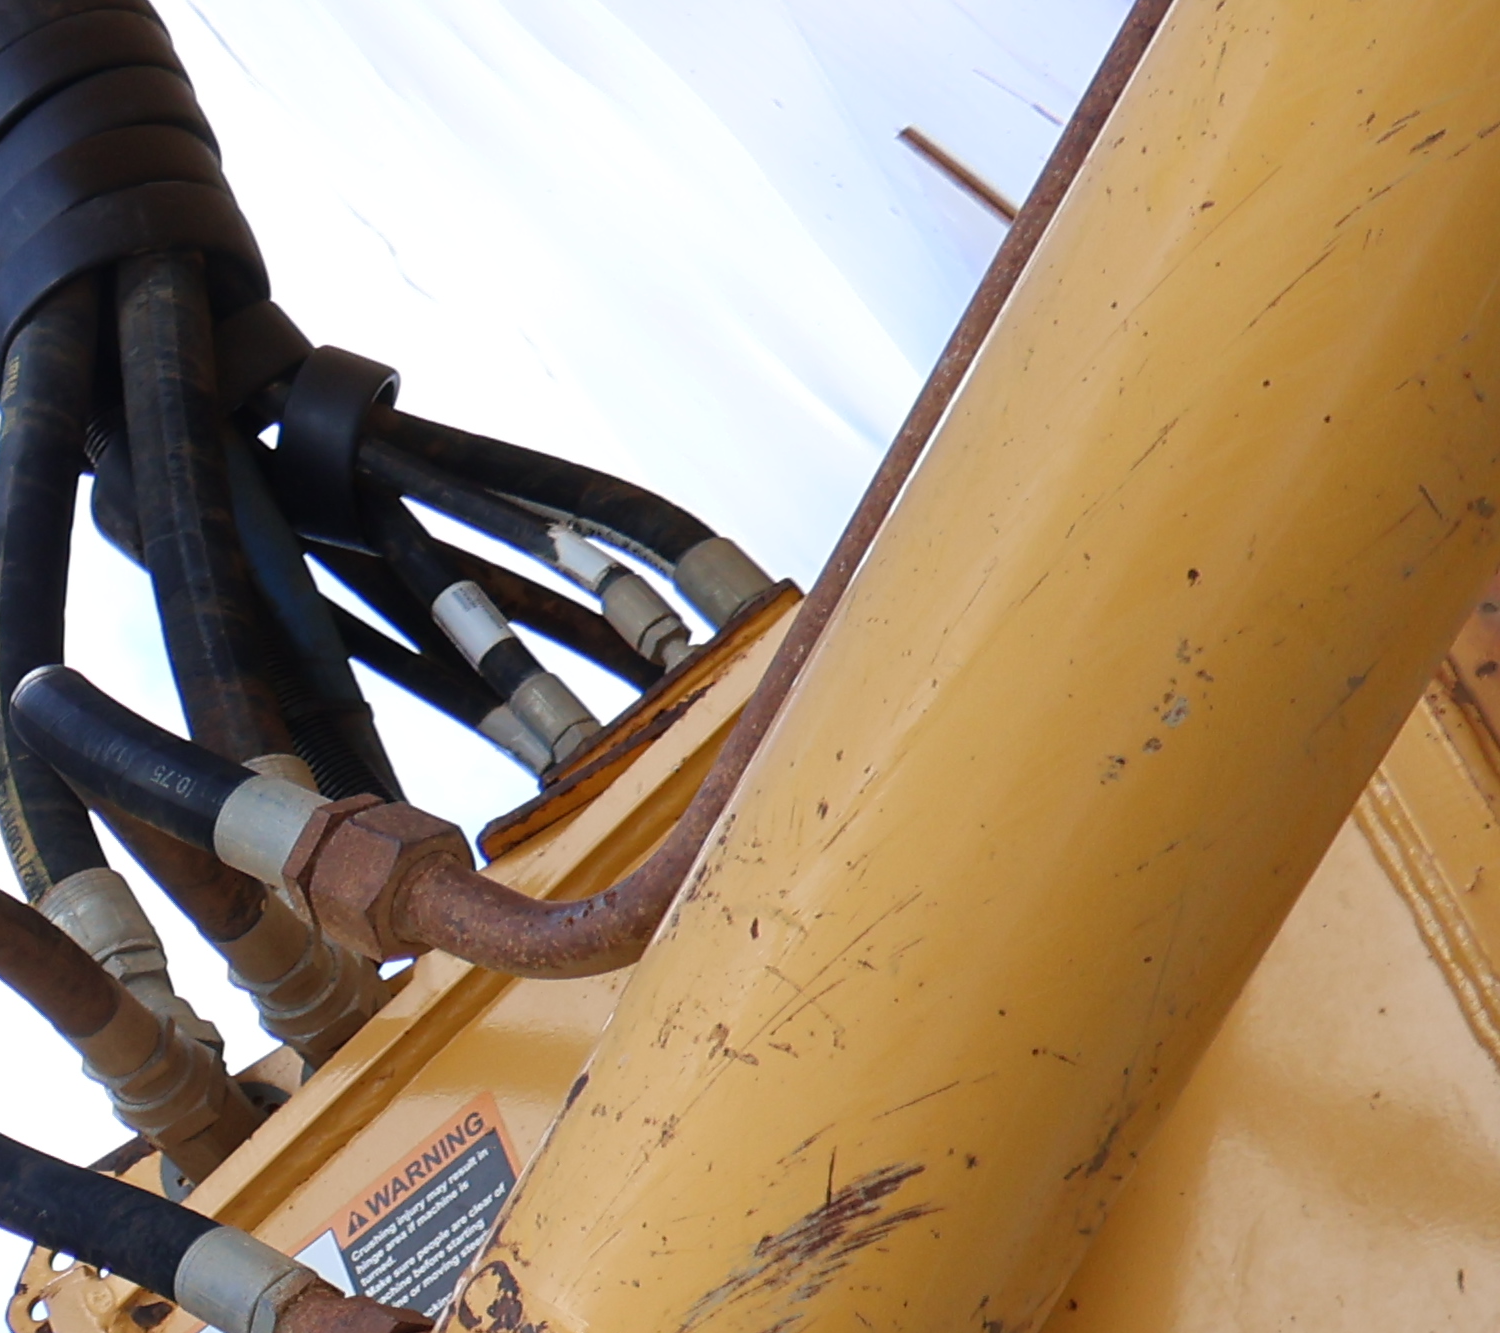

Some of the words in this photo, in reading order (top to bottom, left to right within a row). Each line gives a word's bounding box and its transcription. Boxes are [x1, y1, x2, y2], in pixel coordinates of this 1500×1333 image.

[351, 1223, 398, 1262] Crushing
[395, 1199, 426, 1227] injury
[426, 1181, 448, 1204] may
[447, 1157, 478, 1185] result
[476, 1148, 490, 1162] in
[364, 1112, 485, 1216] WARNING
[355, 1250, 385, 1275] hinge
[386, 1232, 408, 1253] area
[407, 1223, 416, 1234] if
[416, 1191, 459, 1227] machine
[457, 1181, 470, 1194] is
[360, 1257, 397, 1287] turned.
[364, 1277, 393, 1298] Make
[393, 1256, 416, 1279] sure
[416, 1230, 450, 1261] people
[449, 1215, 468, 1233] are
[468, 1194, 494, 1218] clear
[493, 1181, 507, 1198] of
[378, 1275, 413, 1304] achine
[412, 1251, 445, 1279] before
[445, 1218, 487, 1253] starting
[409, 1283, 422, 1298] or
[422, 1254, 461, 1288] moving
